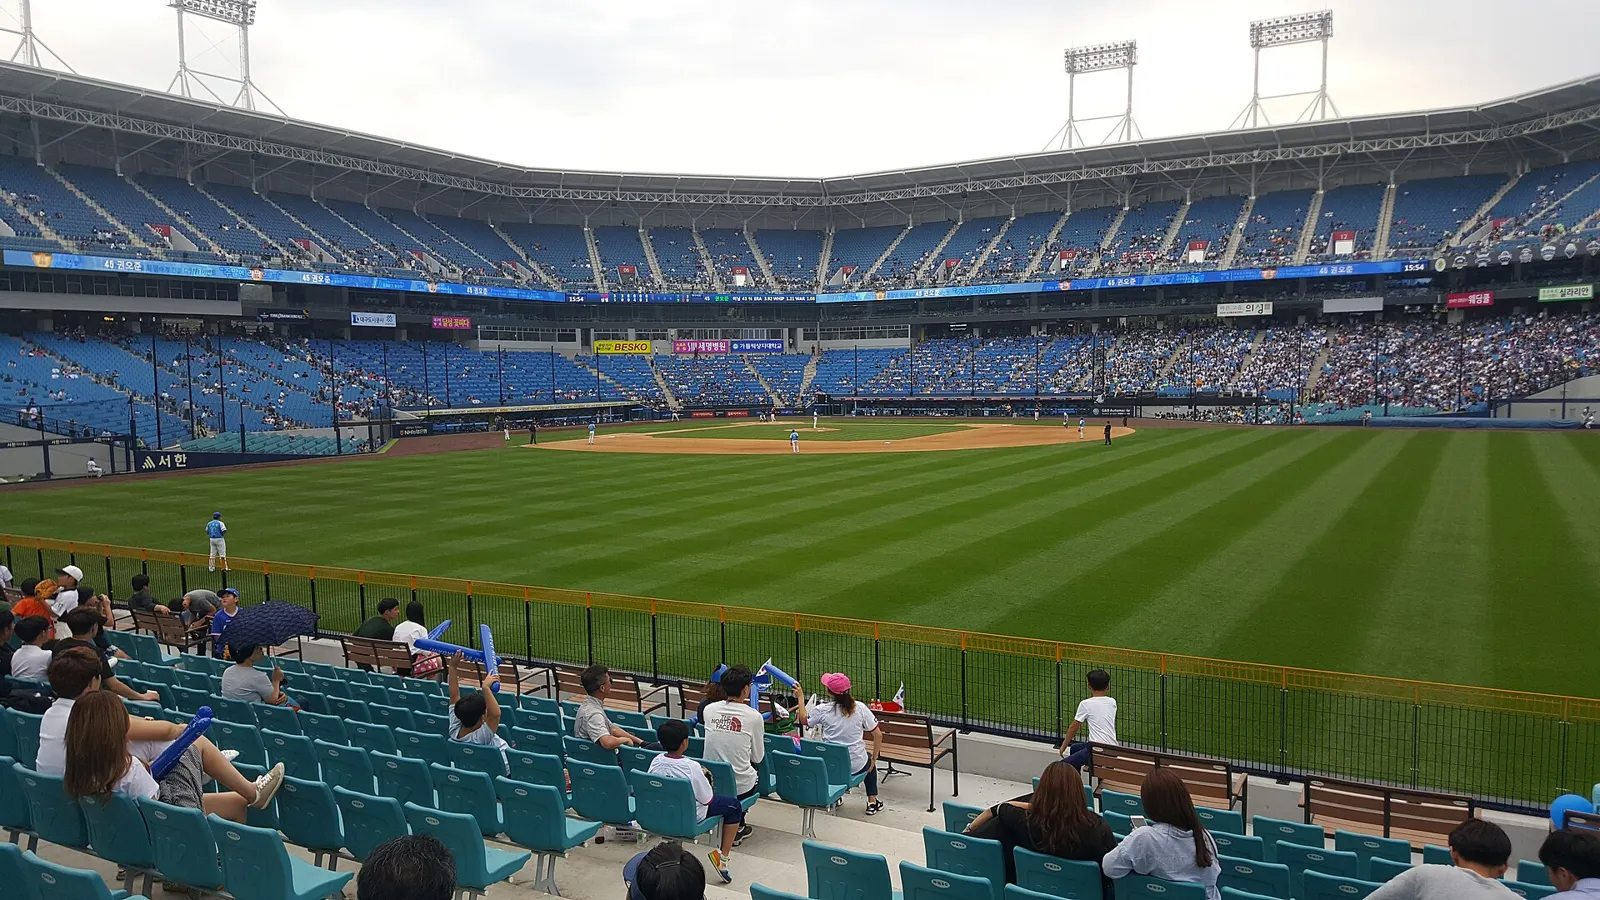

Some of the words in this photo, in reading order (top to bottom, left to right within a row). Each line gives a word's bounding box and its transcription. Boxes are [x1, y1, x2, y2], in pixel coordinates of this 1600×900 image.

[1404, 264, 1425, 272] 15:54
[1559, 286, 1590, 298] 실라리안
[568, 295, 584, 303] 15:54
[614, 343, 649, 351] BESKO
[158, 453, 188, 468] 서한
